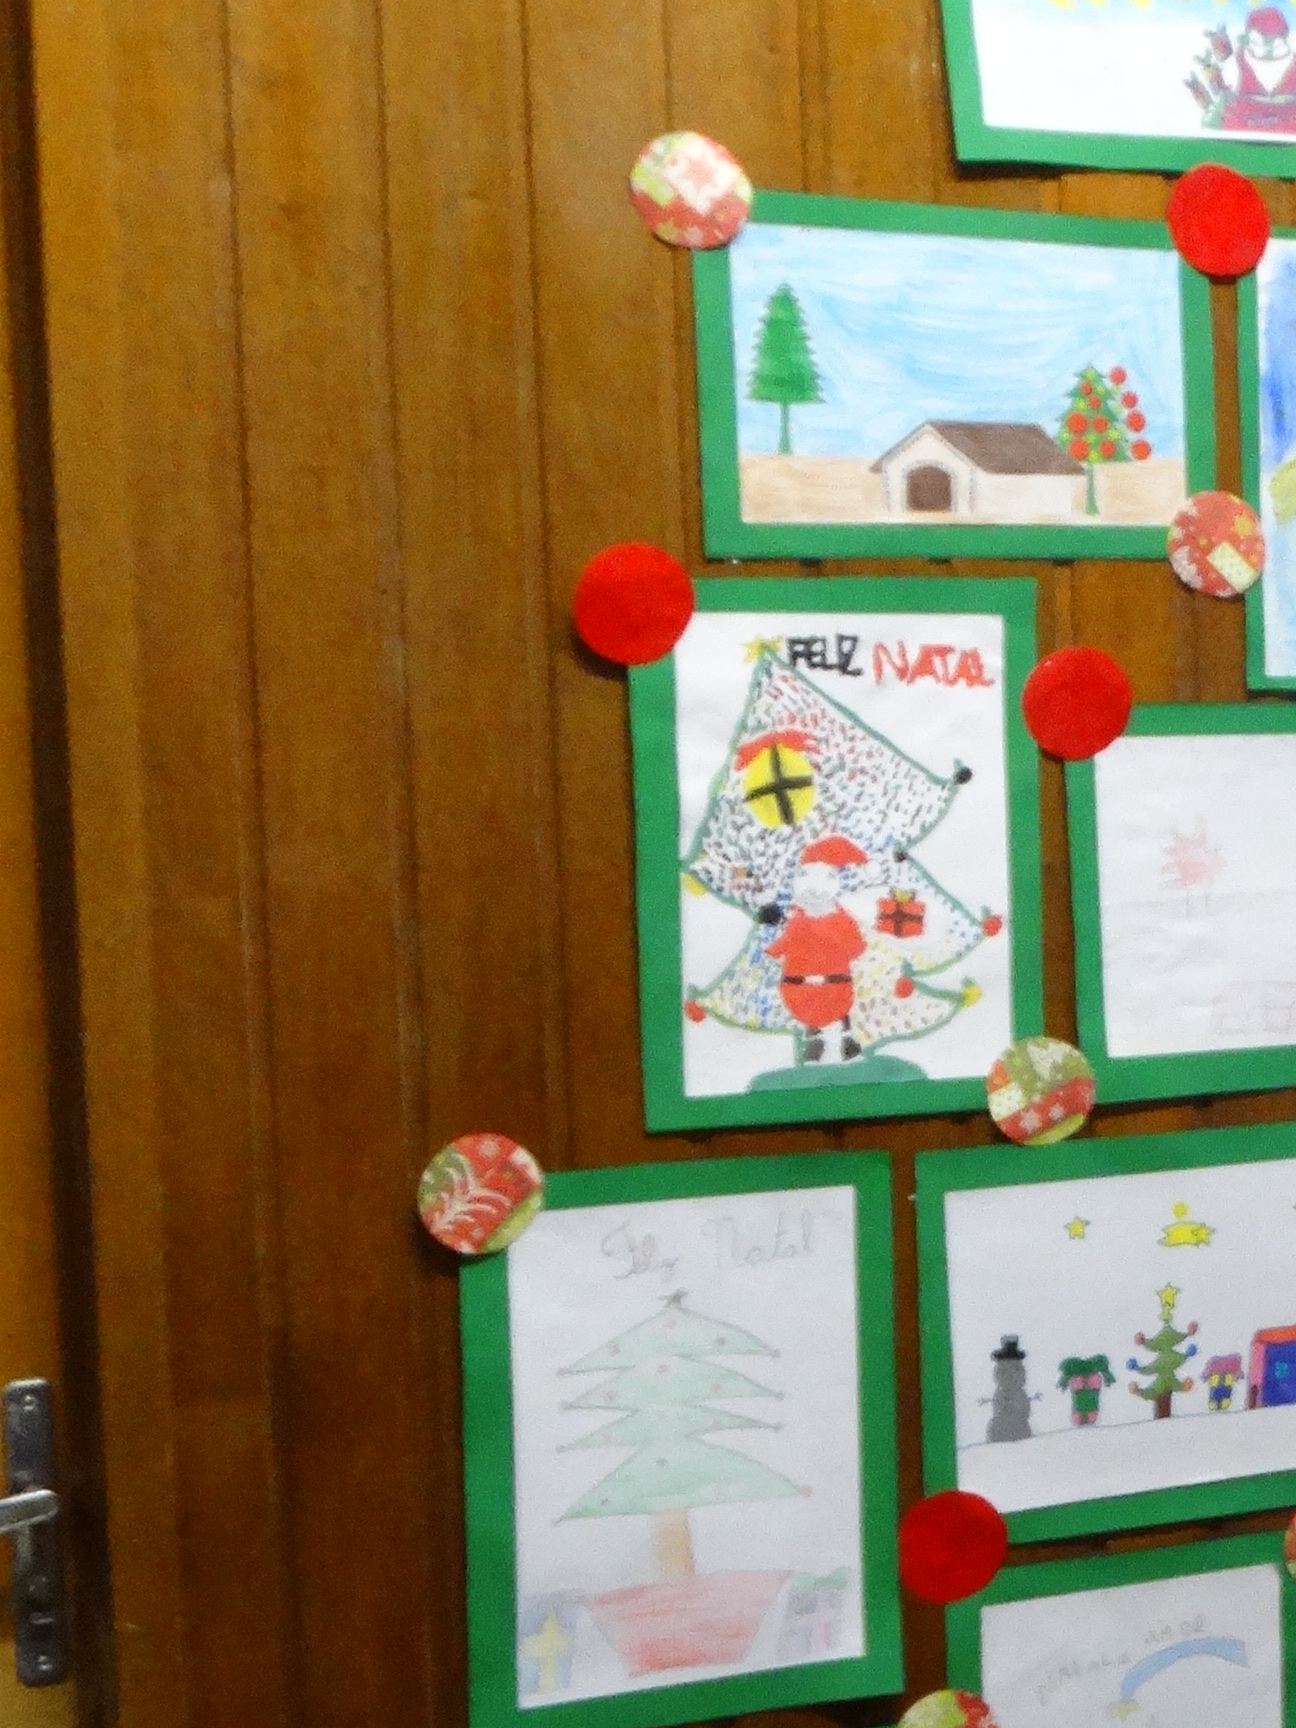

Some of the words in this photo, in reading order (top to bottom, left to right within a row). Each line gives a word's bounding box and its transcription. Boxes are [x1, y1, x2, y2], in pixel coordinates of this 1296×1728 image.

[786, 632, 864, 677] FELIZ
[871, 639, 995, 688] NATAL
[700, 1209, 814, 1270] Natal
